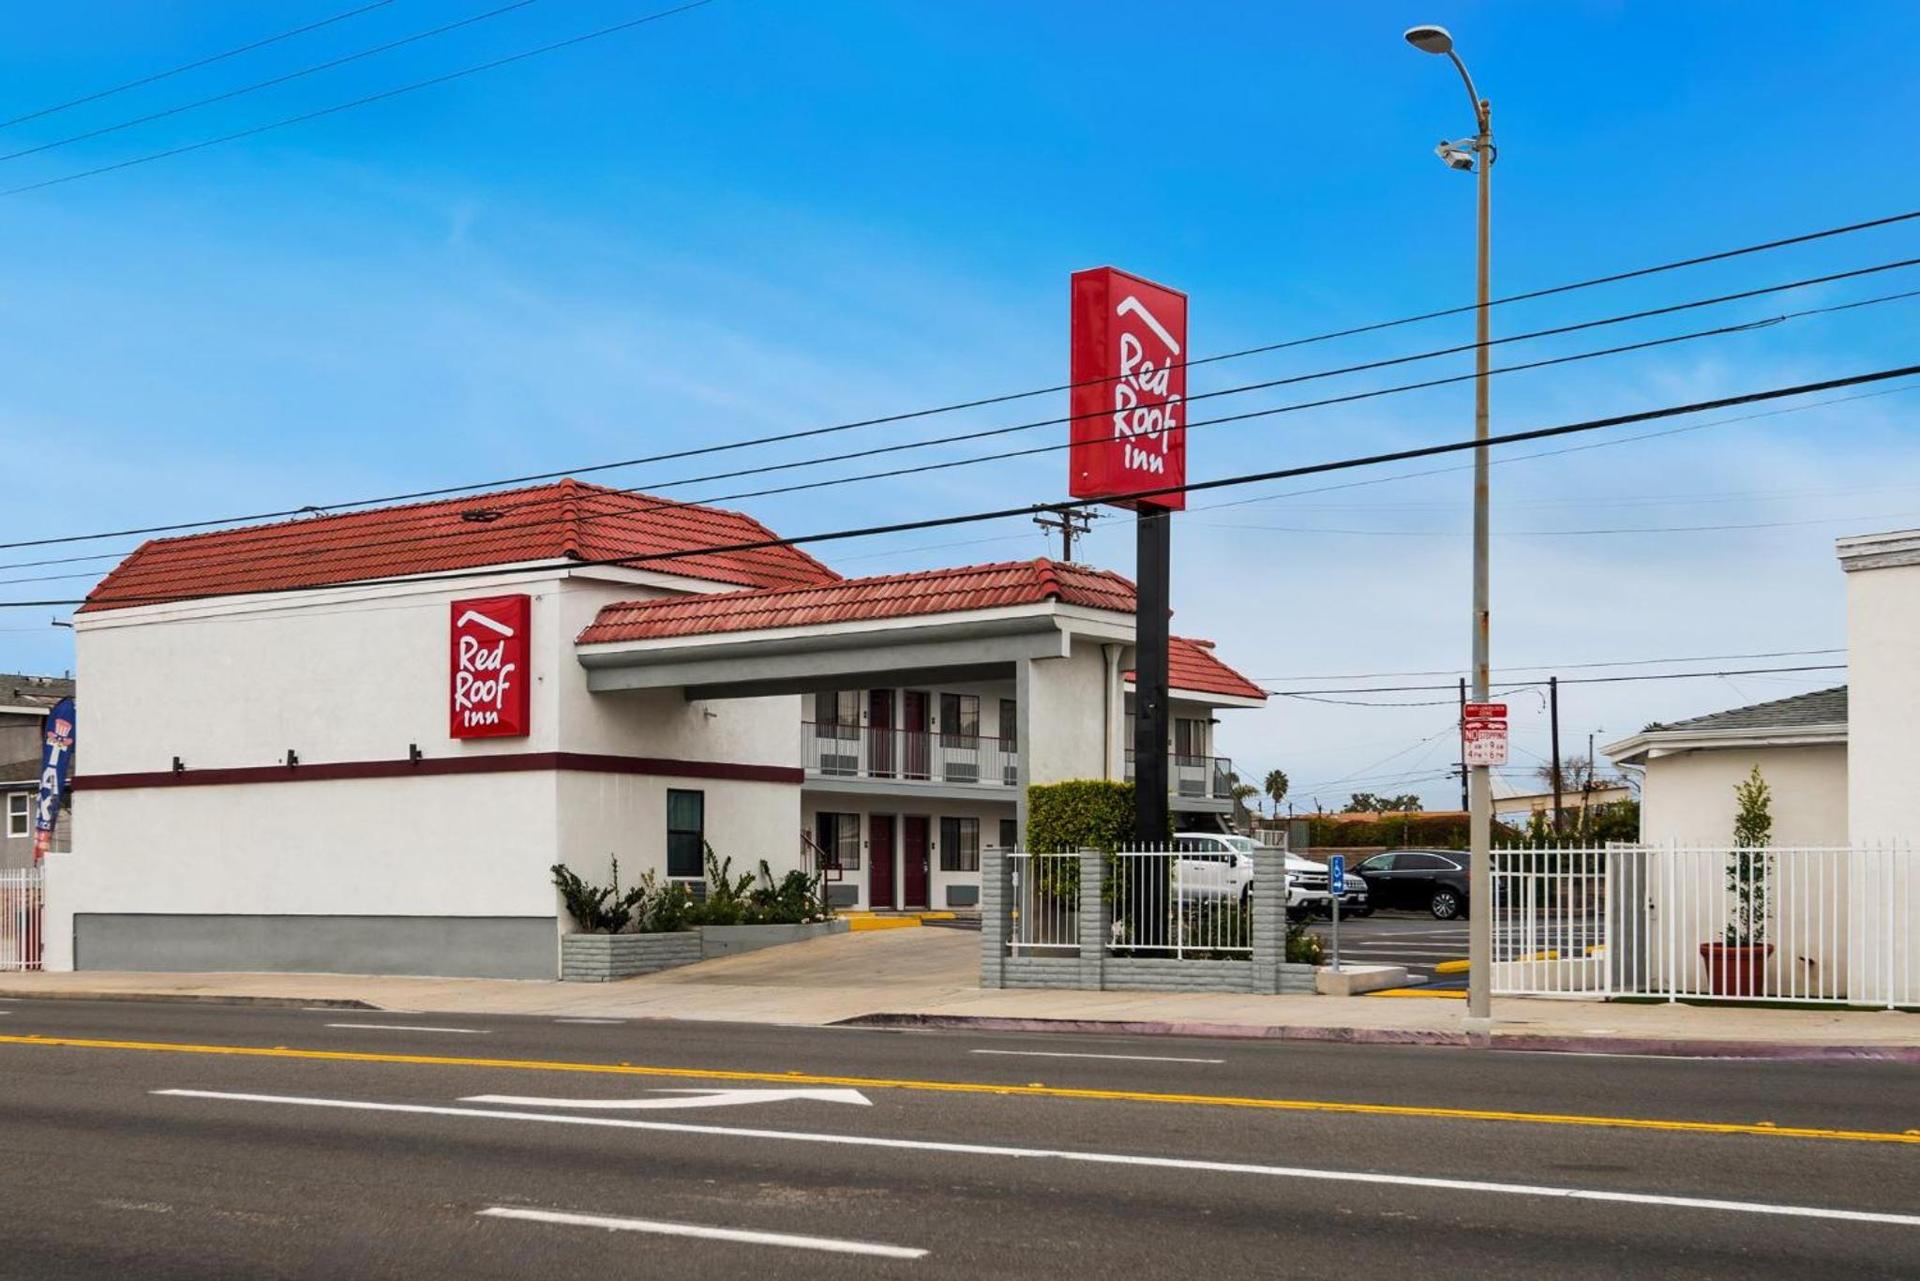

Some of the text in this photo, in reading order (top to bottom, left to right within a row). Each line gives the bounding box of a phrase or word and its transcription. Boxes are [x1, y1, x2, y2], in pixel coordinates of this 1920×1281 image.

[1120, 332, 1171, 397] Red
[1113, 383, 1181, 454] Roof
[459, 635, 505, 673] Red
[454, 663, 515, 712] Roof
[1465, 730, 1478, 740] NO
